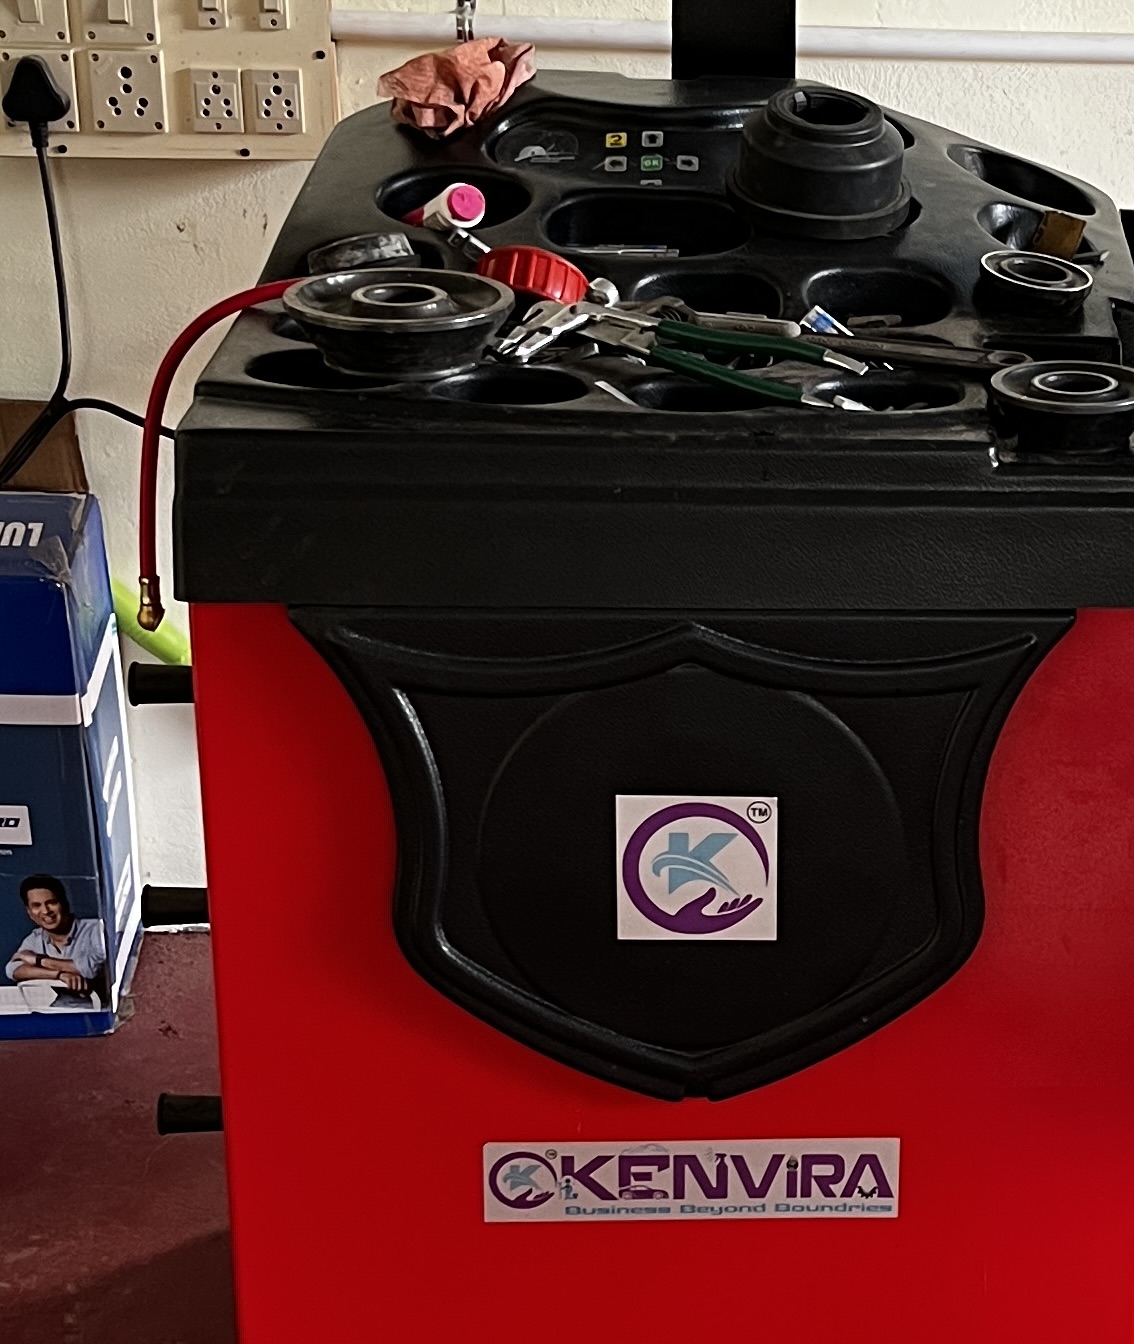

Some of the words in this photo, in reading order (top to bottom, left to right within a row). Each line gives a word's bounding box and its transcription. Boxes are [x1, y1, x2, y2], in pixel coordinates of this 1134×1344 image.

[643, 158, 661, 167] OK
[0, 521, 44, 547] LU
[750, 807, 769, 817] TM
[565, 1206, 671, 1216] Business
[680, 1204, 766, 1216] Beyond
[774, 1202, 892, 1213] Boundries
